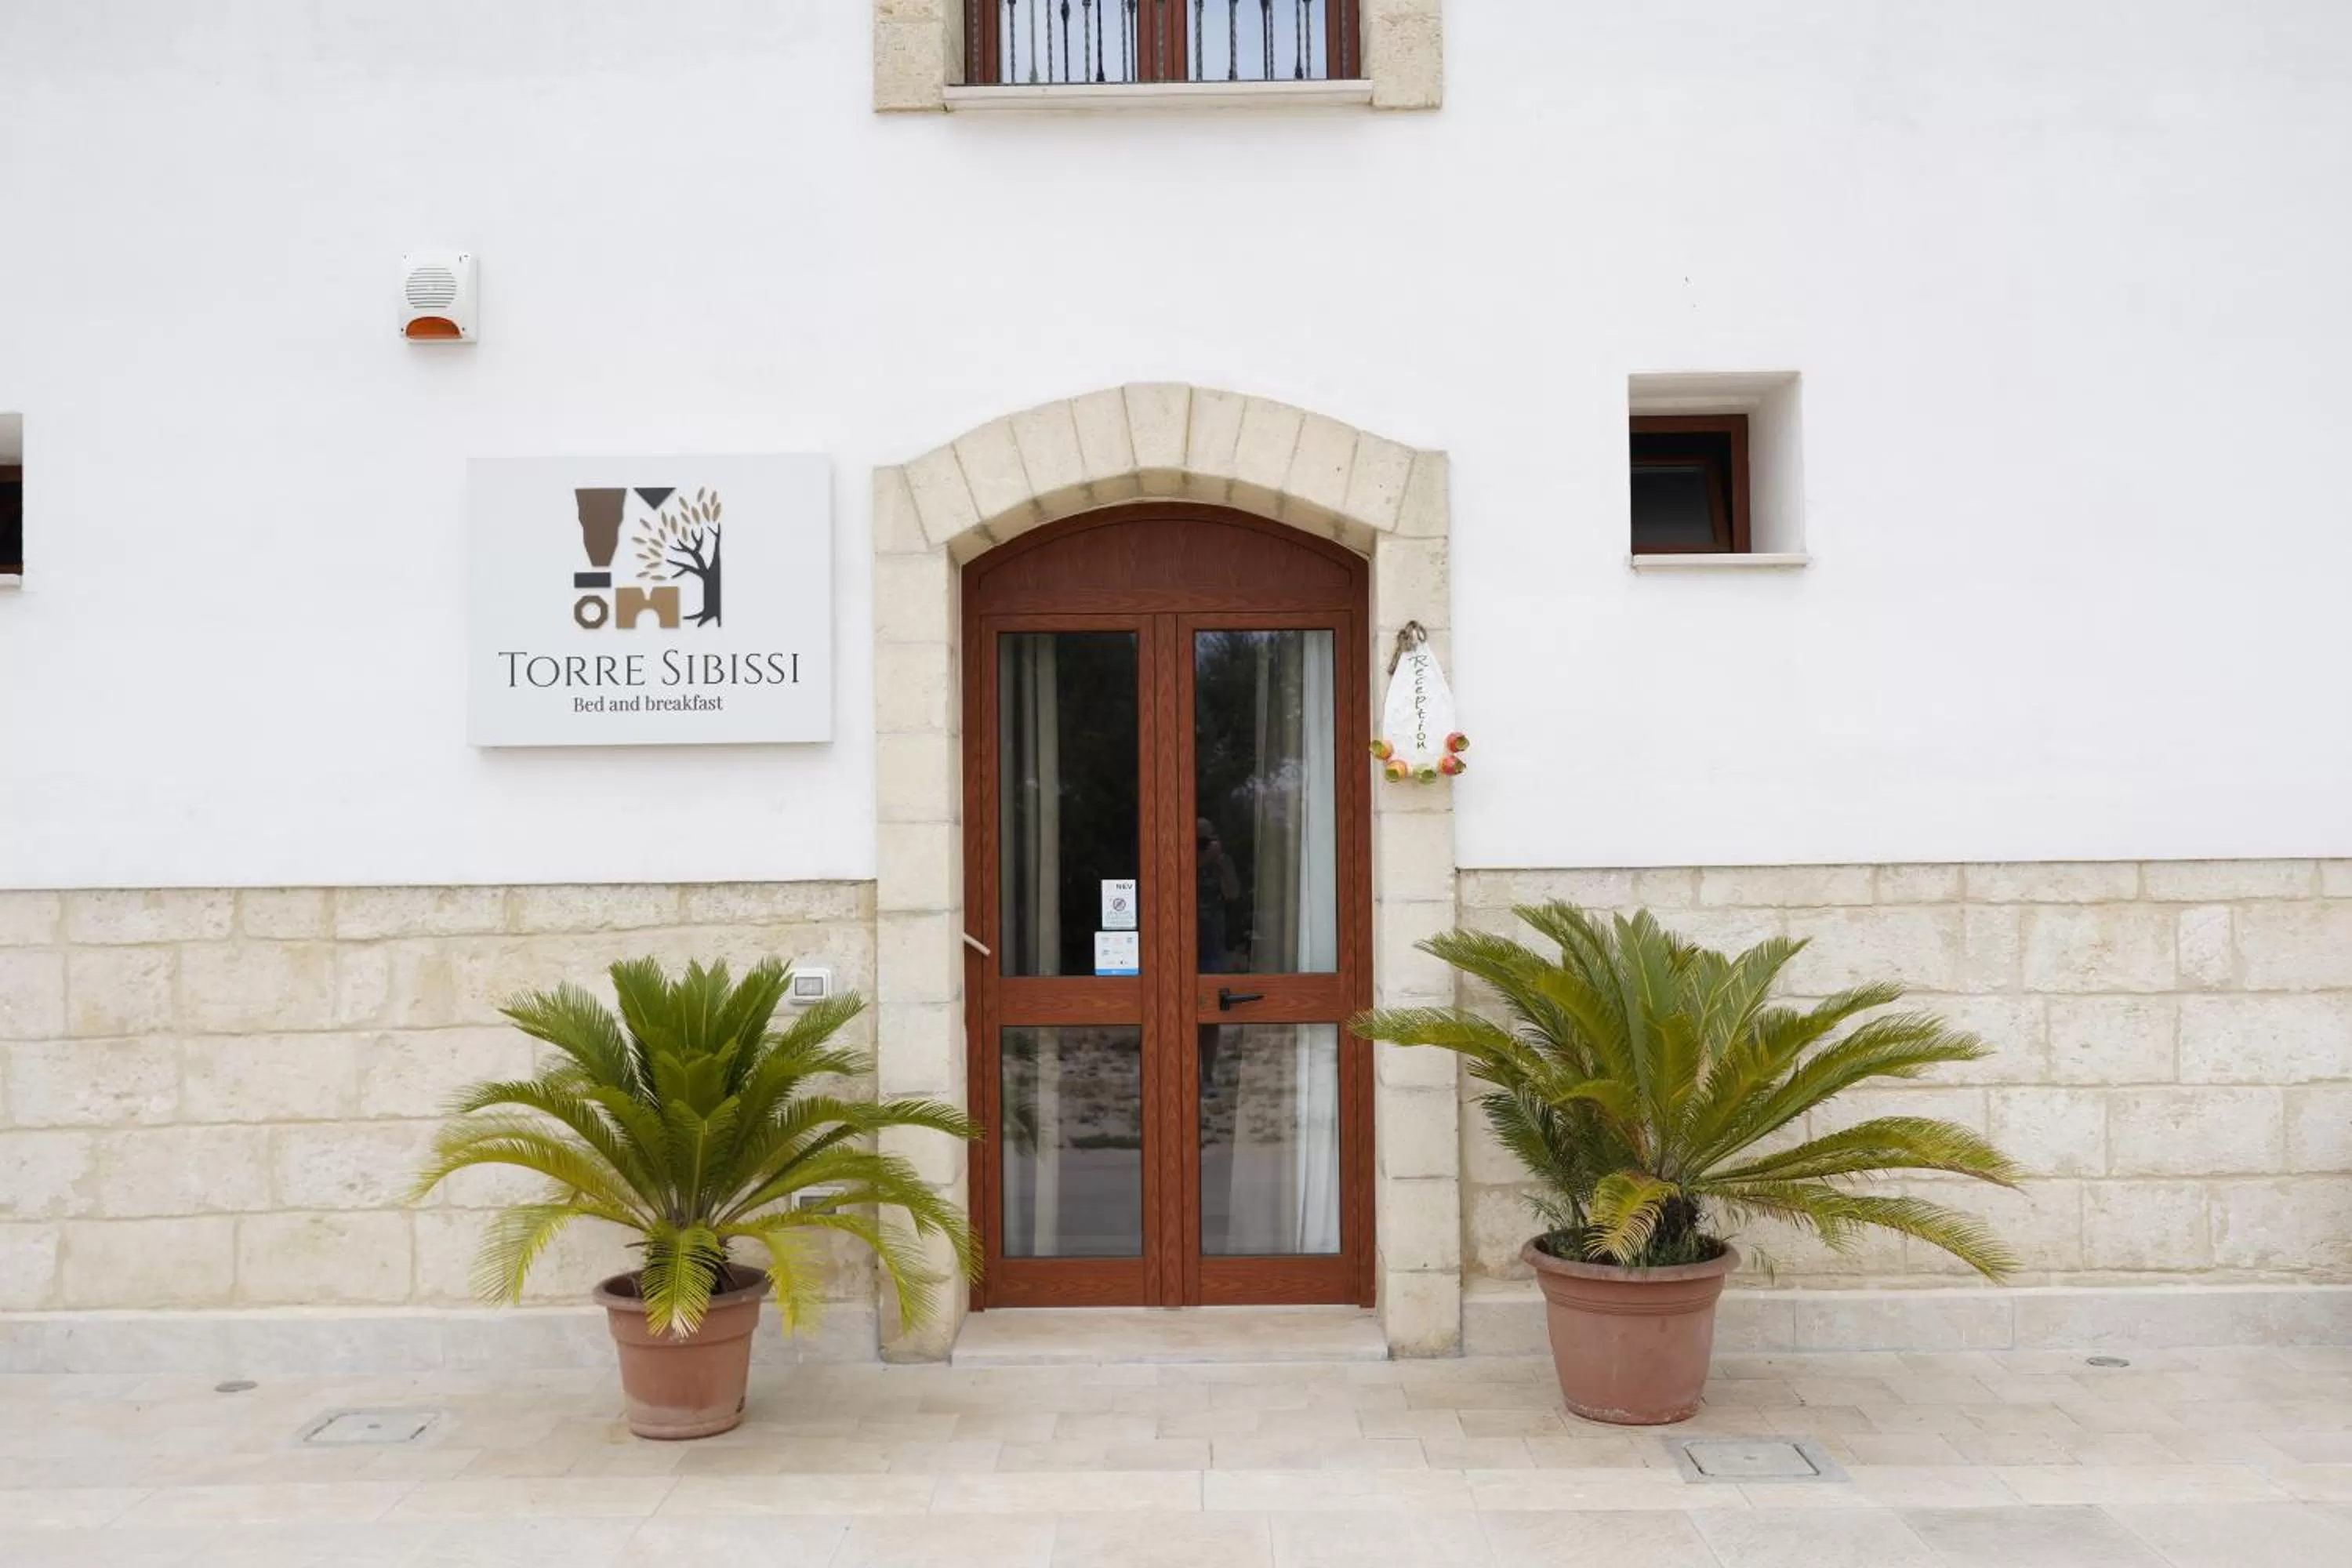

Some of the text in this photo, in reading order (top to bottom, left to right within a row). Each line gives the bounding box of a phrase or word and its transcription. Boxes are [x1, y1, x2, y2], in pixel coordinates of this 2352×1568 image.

[498, 649, 800, 688] TORRE SIBISSI
[573, 694, 724, 713] Bed and breakfast
